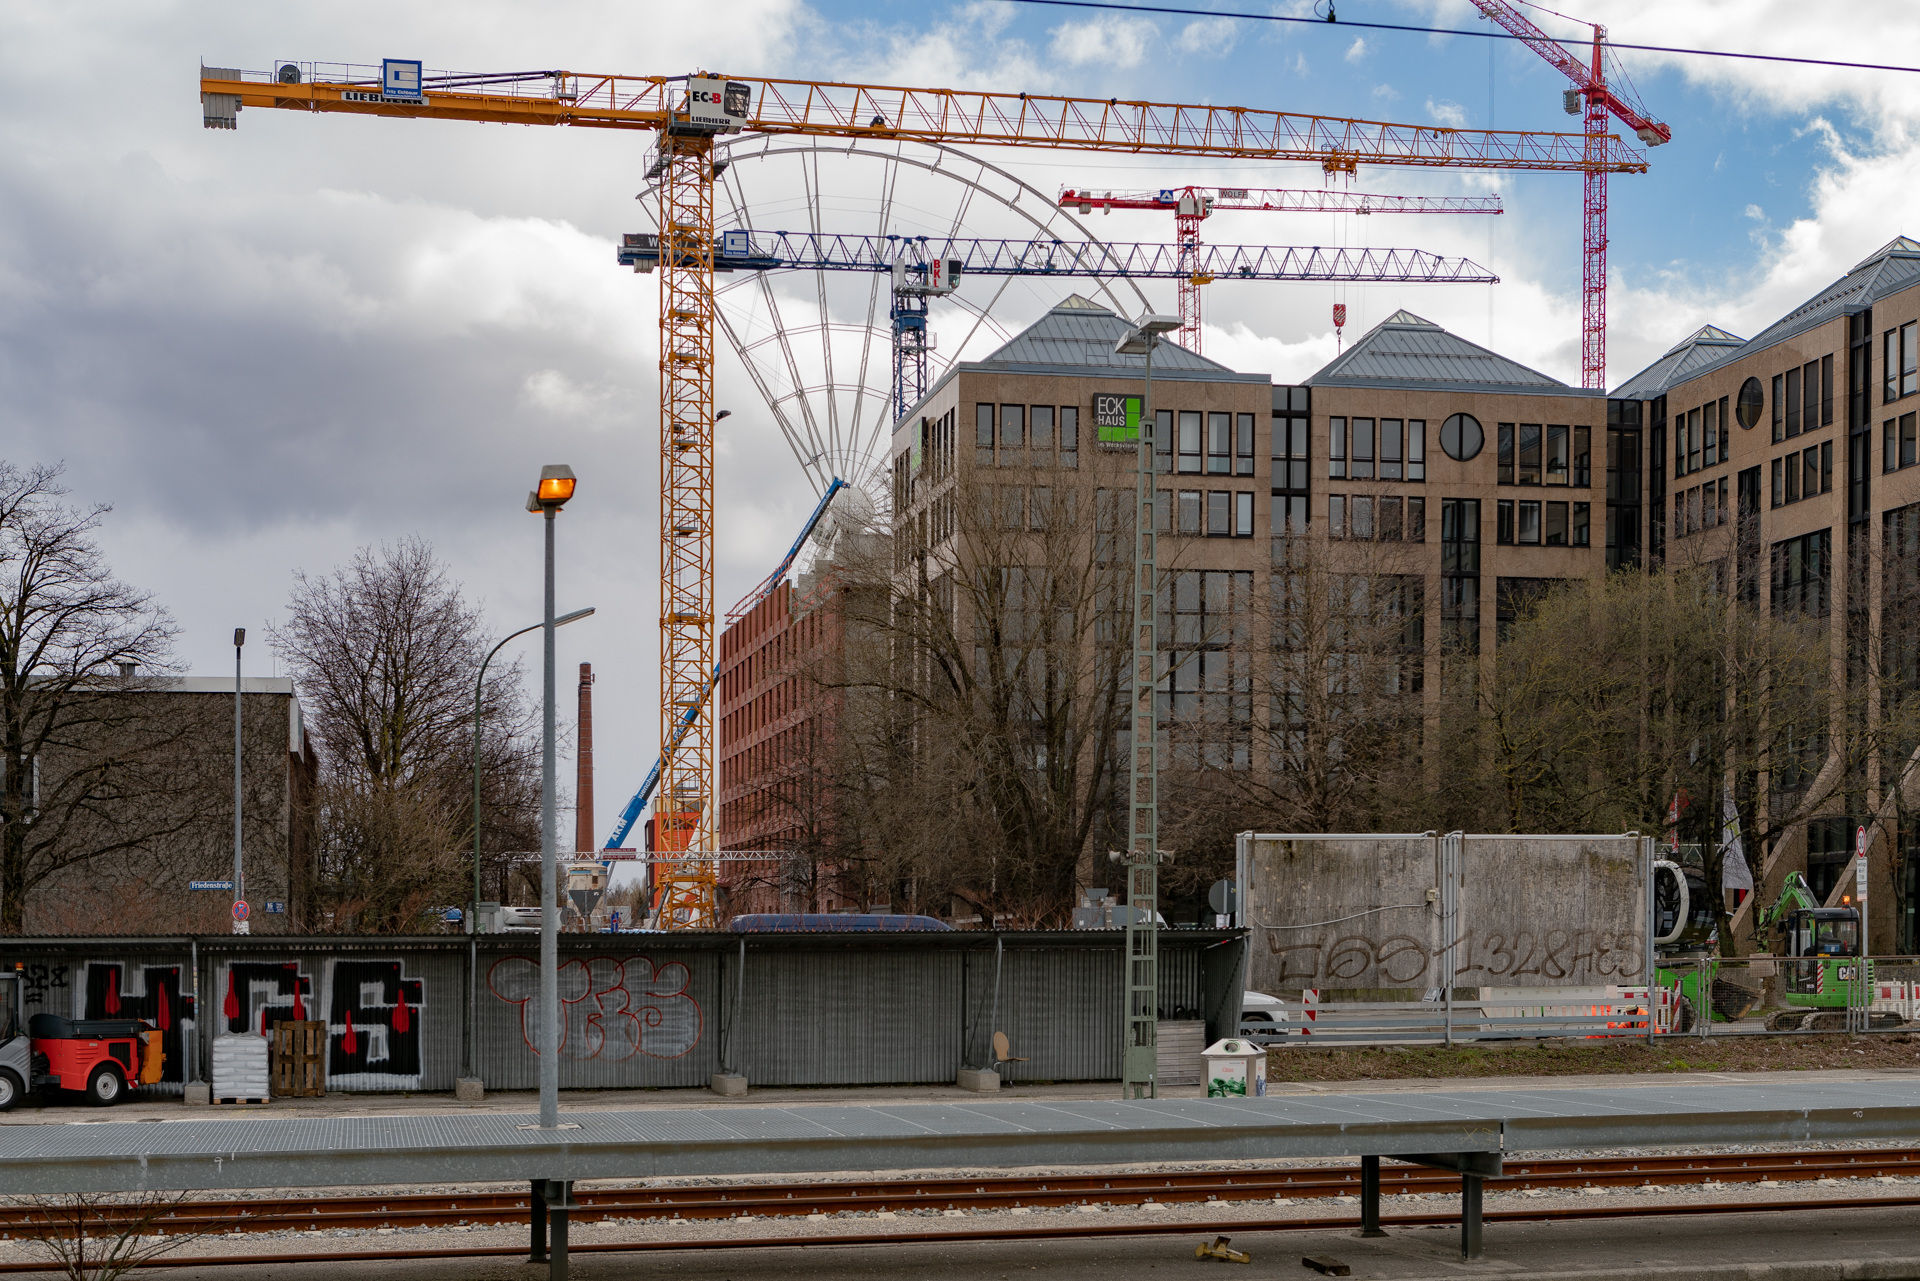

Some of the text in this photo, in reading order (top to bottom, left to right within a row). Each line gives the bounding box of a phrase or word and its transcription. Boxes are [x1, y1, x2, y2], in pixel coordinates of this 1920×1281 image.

[692, 91, 722, 104] EC-B
[691, 116, 731, 125] LIEBHERR
[1098, 396, 1125, 415] ECK
[1098, 415, 1126, 426] HAUS
[610, 818, 628, 842] AKM
[191, 882, 233, 890] Friedenstraße
